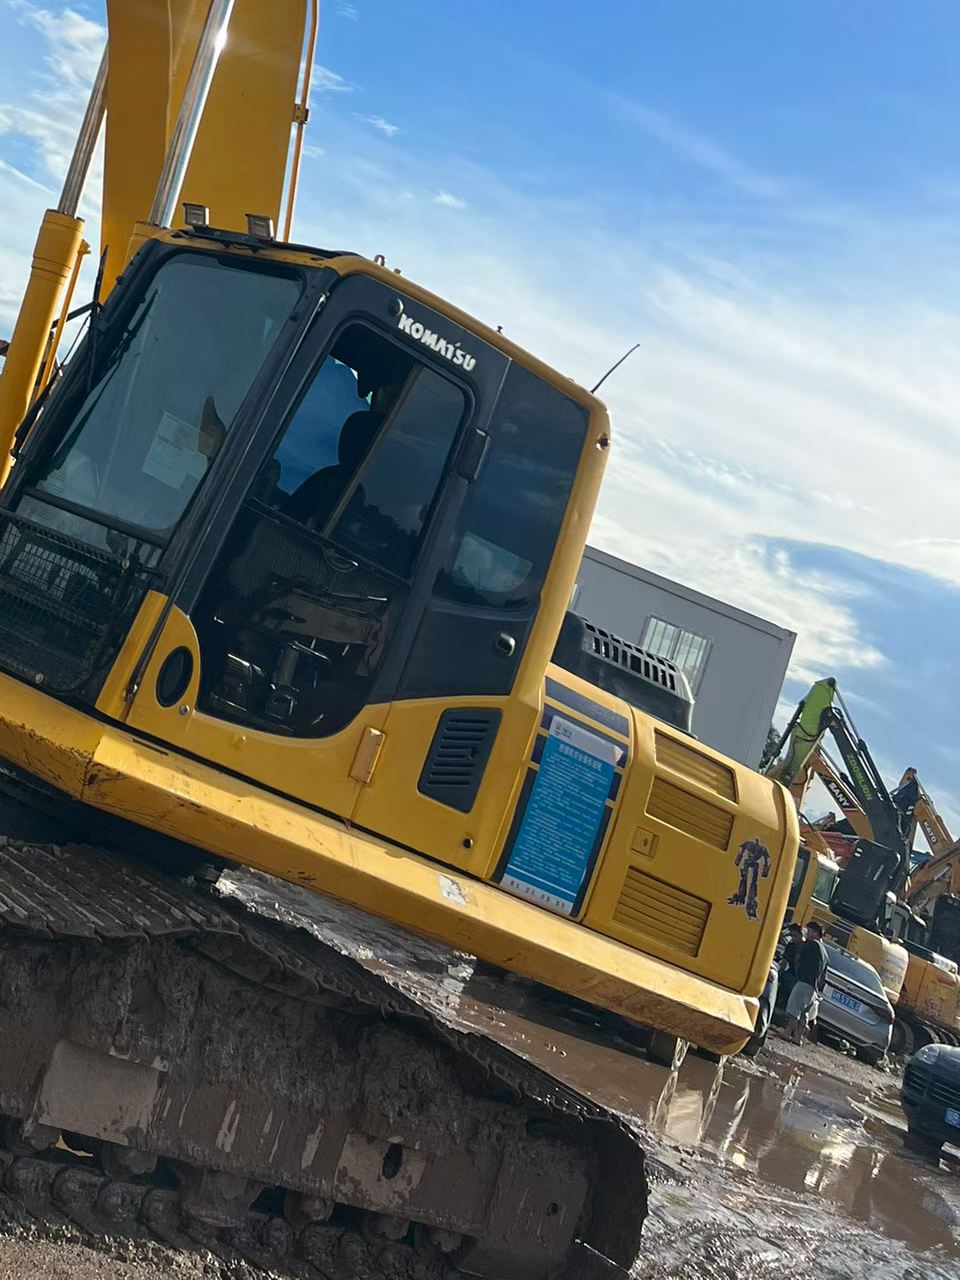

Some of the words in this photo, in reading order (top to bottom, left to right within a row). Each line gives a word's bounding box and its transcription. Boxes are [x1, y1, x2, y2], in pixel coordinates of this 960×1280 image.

[398, 313, 476, 371] KOMATSU
[829, 782, 850, 807] SANY
[847, 755, 873, 800] ZOOMLION
[923, 821, 937, 843] KATO
